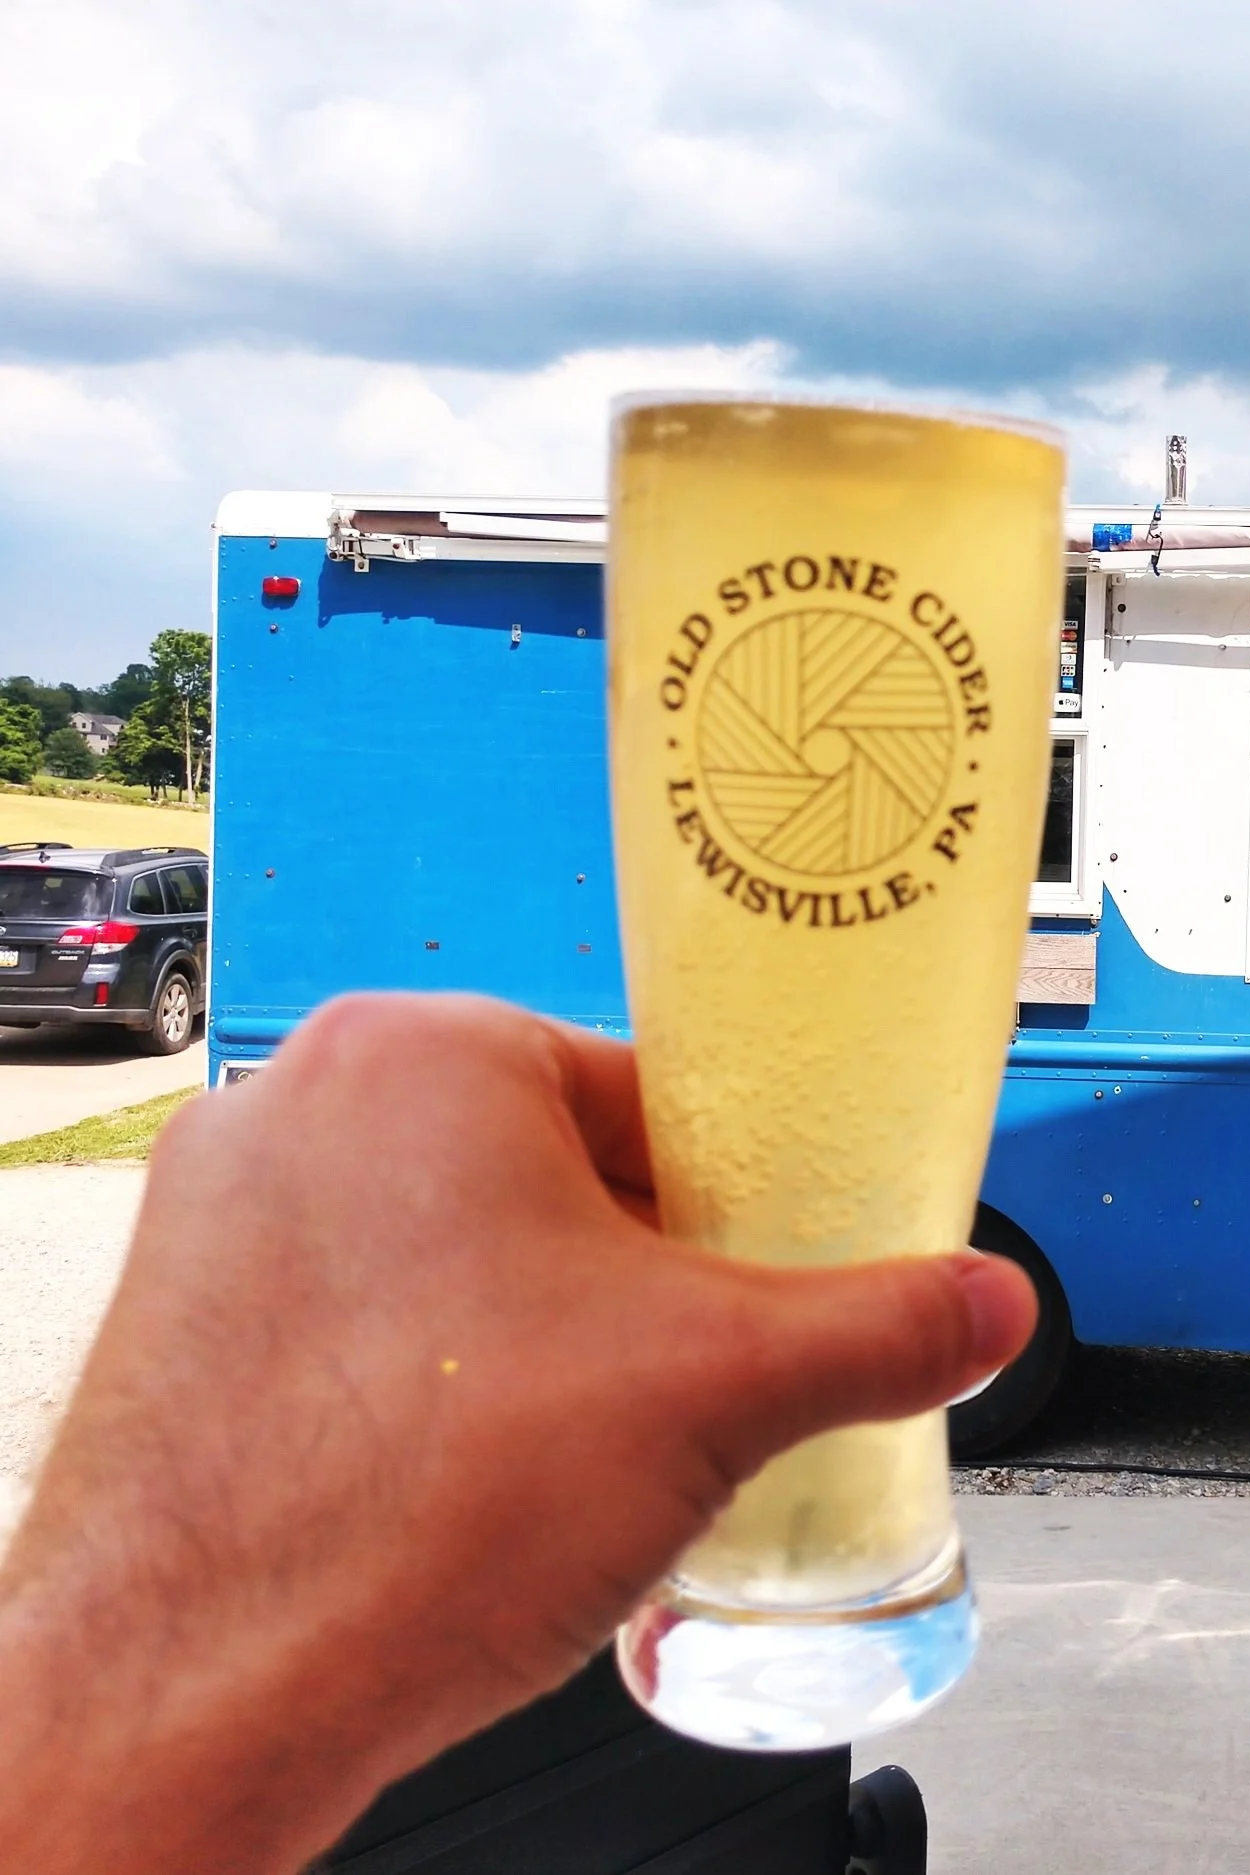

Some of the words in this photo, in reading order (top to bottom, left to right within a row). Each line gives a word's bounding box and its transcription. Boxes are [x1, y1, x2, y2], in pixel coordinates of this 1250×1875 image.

[660, 612, 714, 711] OLD
[717, 555, 898, 616] STONE
[909, 591, 992, 736] CIDER
[1065, 699, 1079, 707] Pay
[667, 776, 937, 929] LEWISVILLE,
[931, 801, 979, 864] PA
